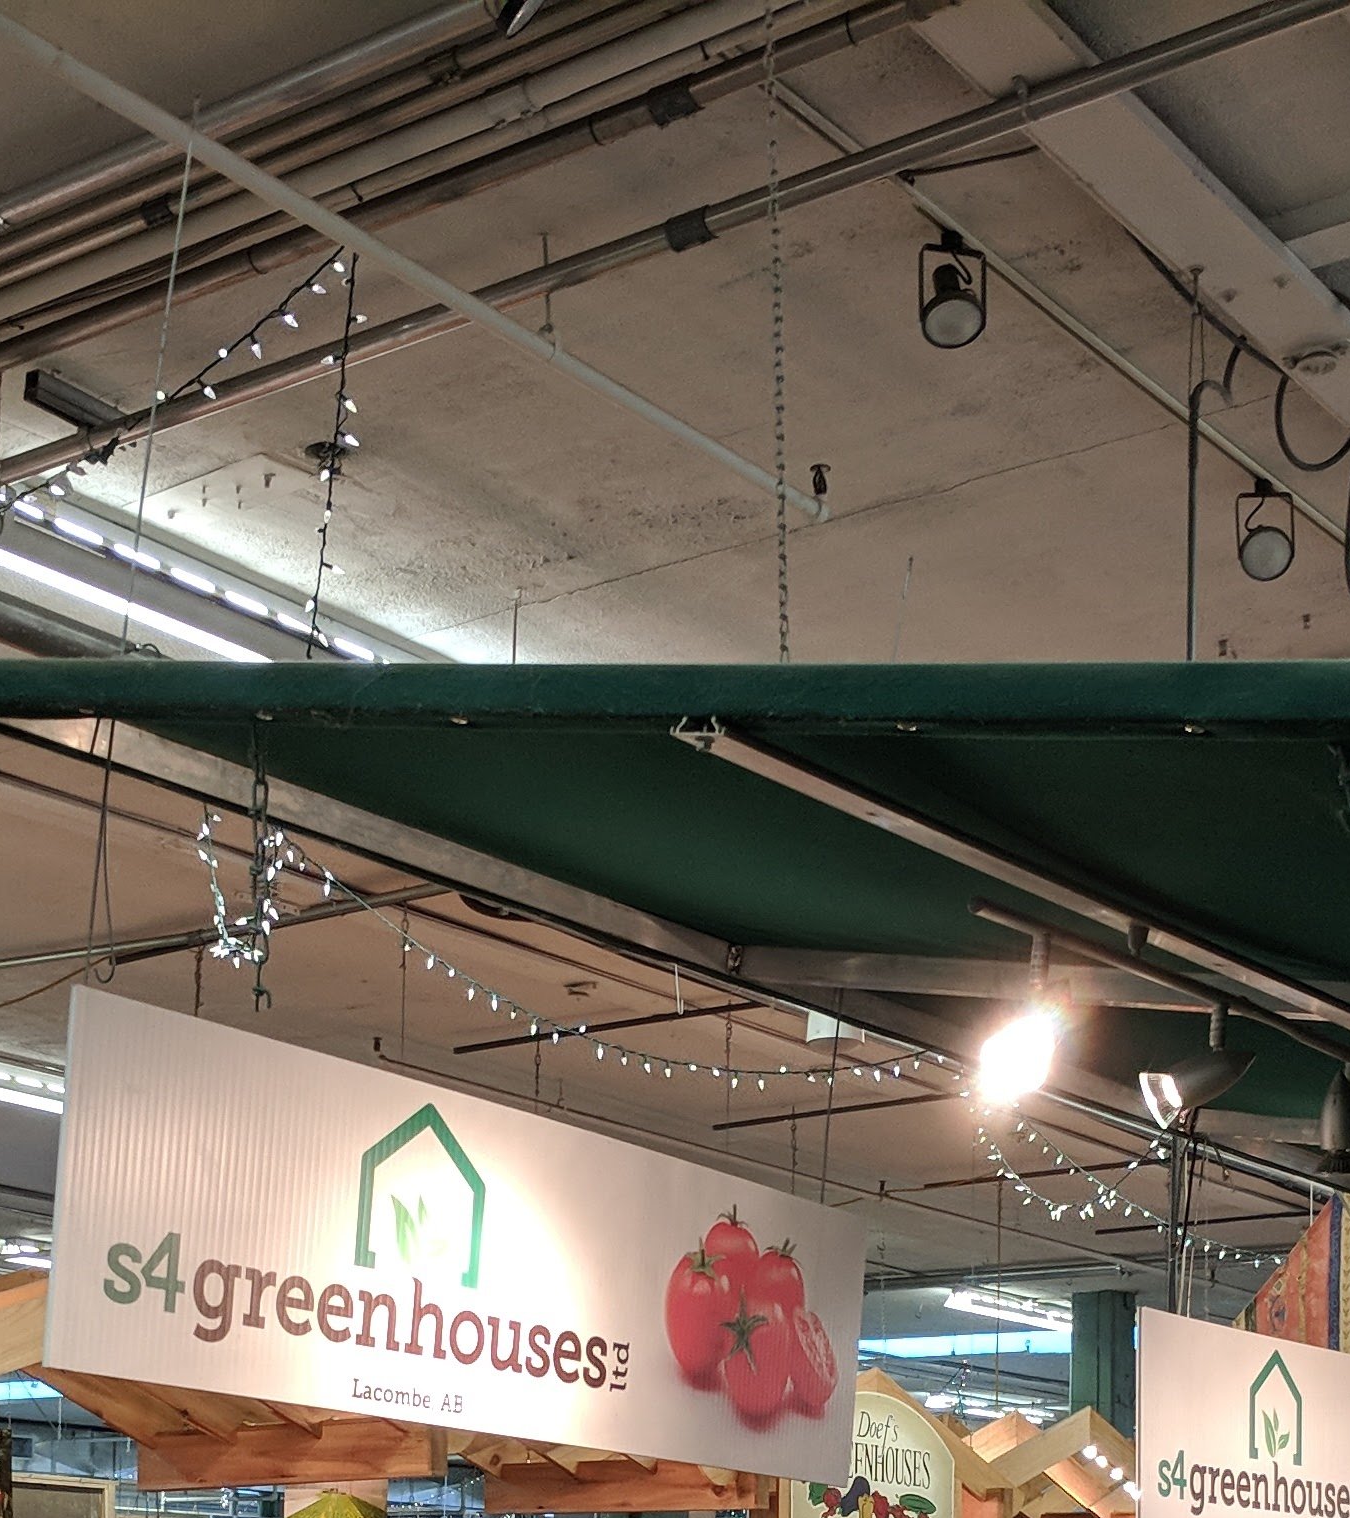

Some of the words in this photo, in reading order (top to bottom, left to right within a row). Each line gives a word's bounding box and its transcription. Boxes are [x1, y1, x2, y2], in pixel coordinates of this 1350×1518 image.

[609, 1341, 632, 1394] ltd
[441, 1393, 463, 1413] AB
[849, 1442, 931, 1490] ENHOUSES
